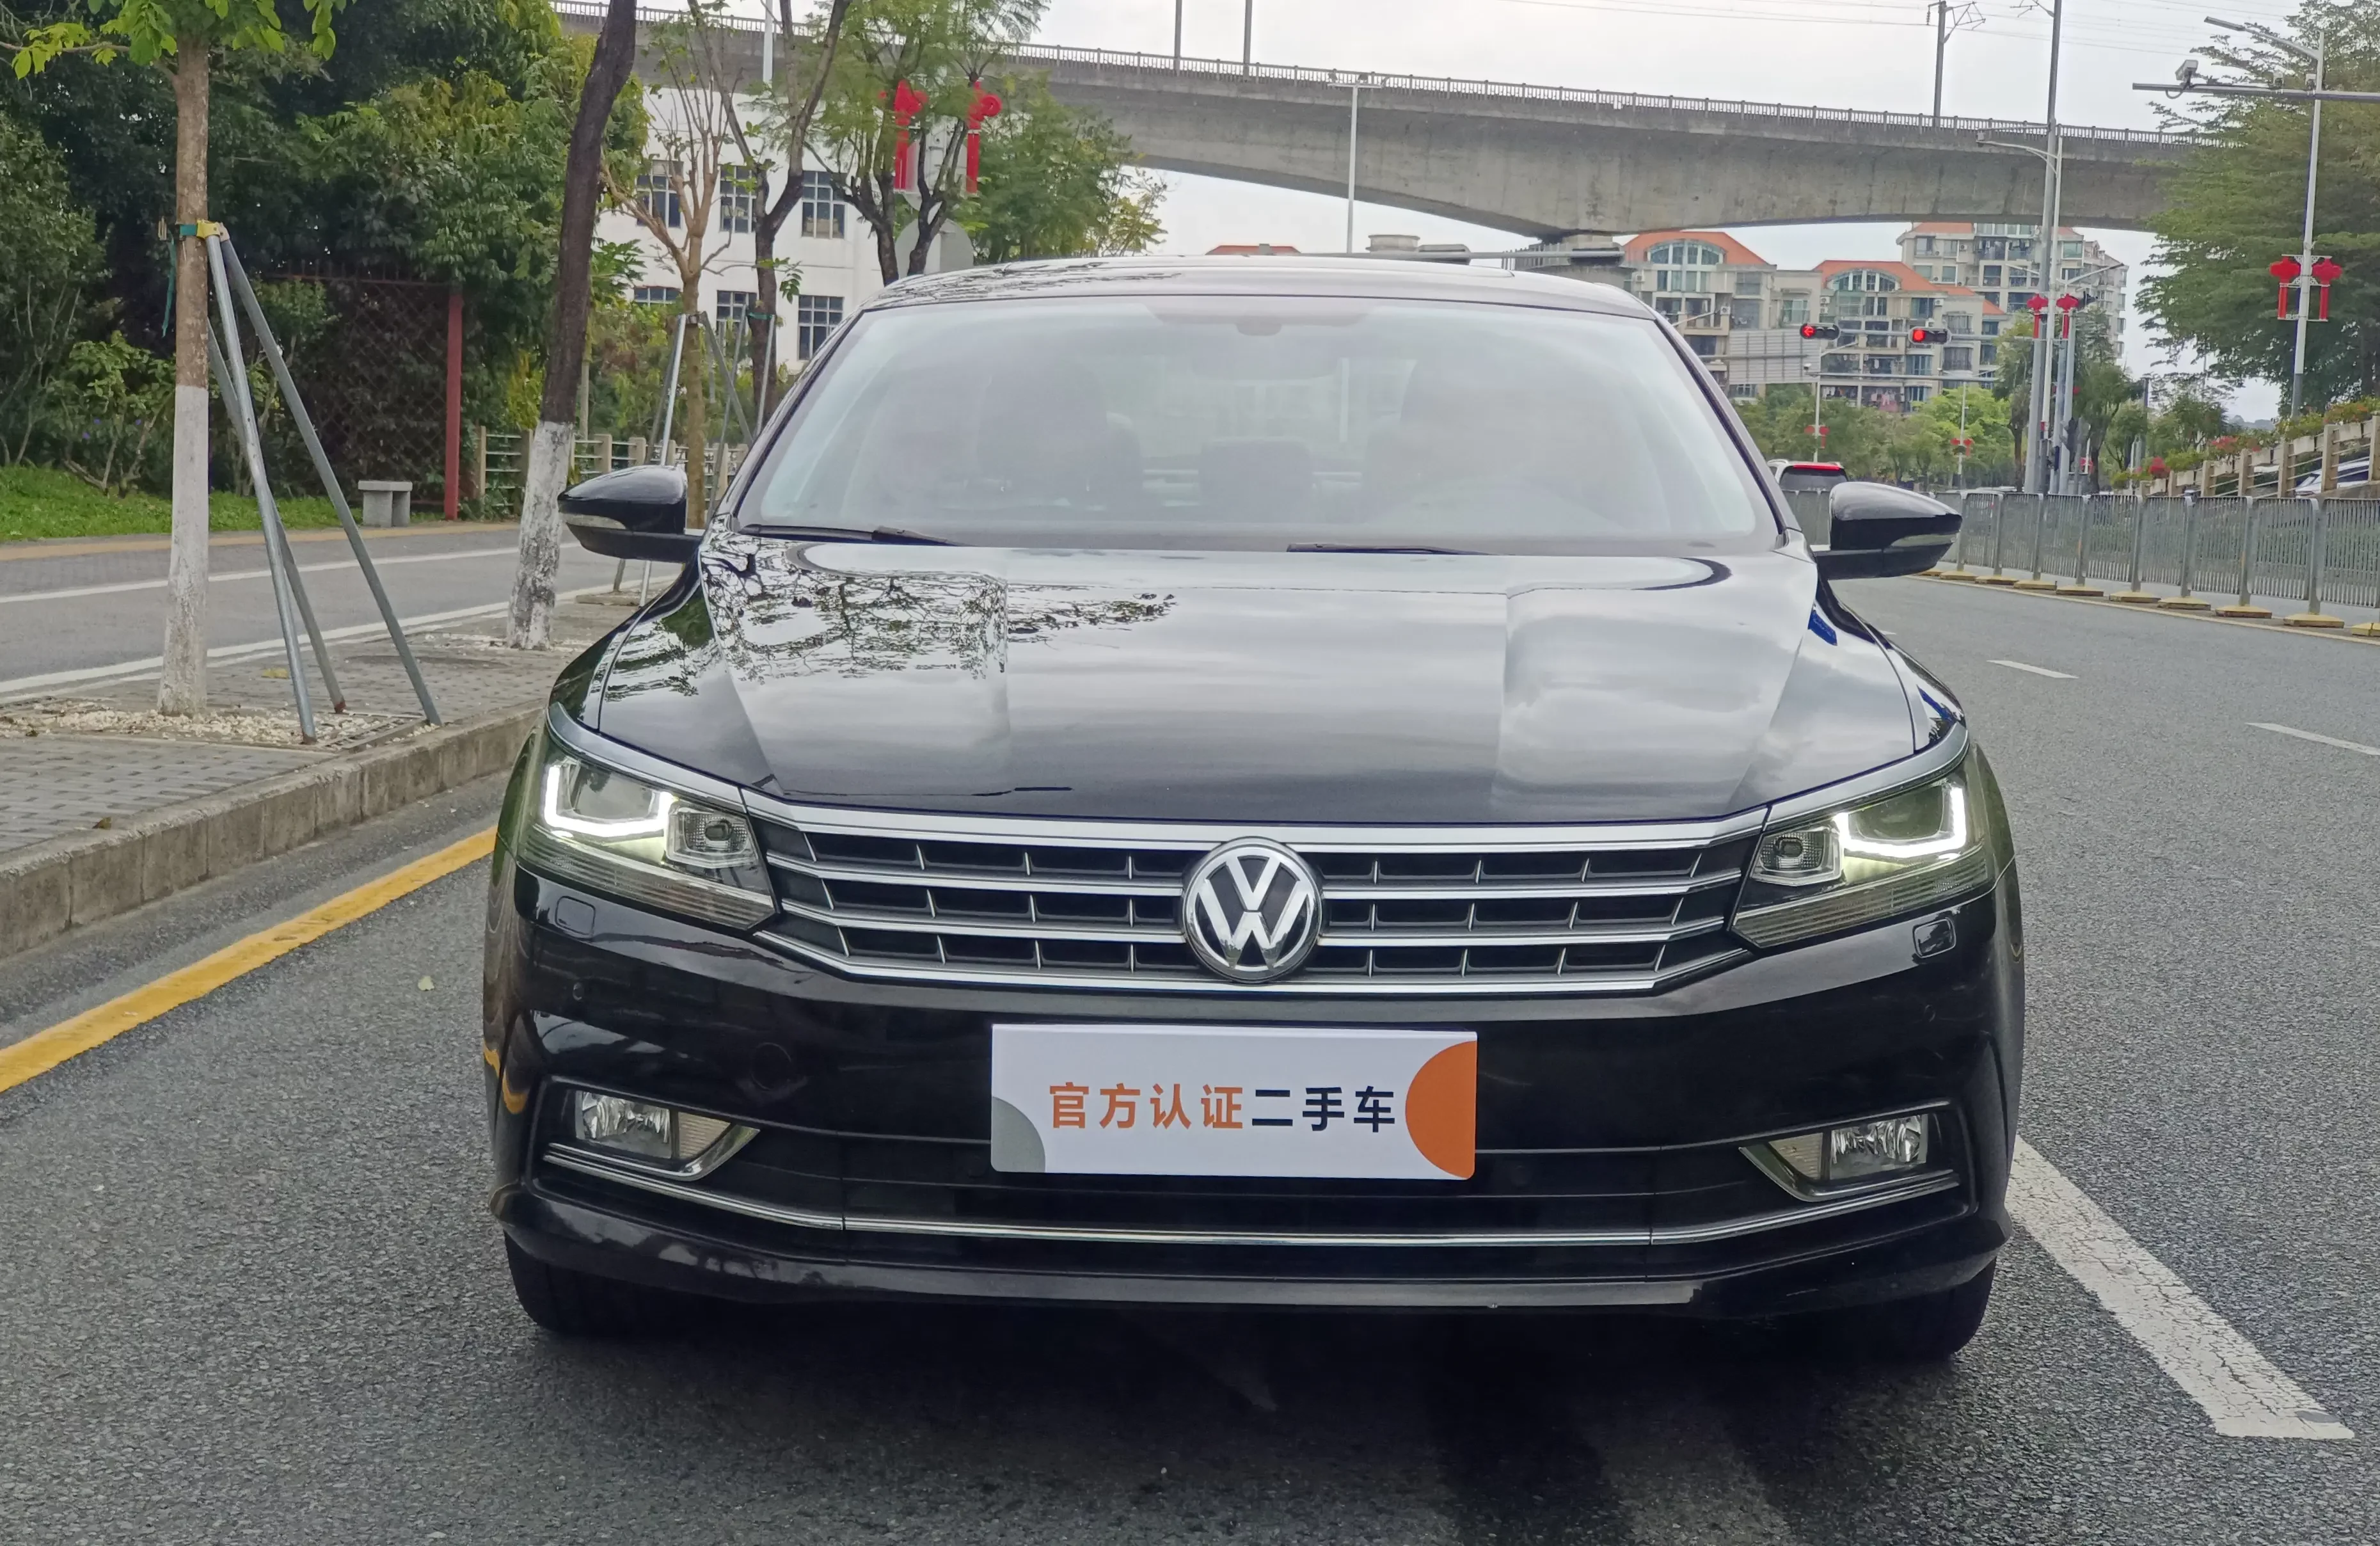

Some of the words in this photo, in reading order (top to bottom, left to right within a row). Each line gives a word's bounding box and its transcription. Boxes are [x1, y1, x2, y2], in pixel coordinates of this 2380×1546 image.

[1191, 850, 1313, 969] VW
[1049, 1081, 1396, 1133] 官方认证二手车
